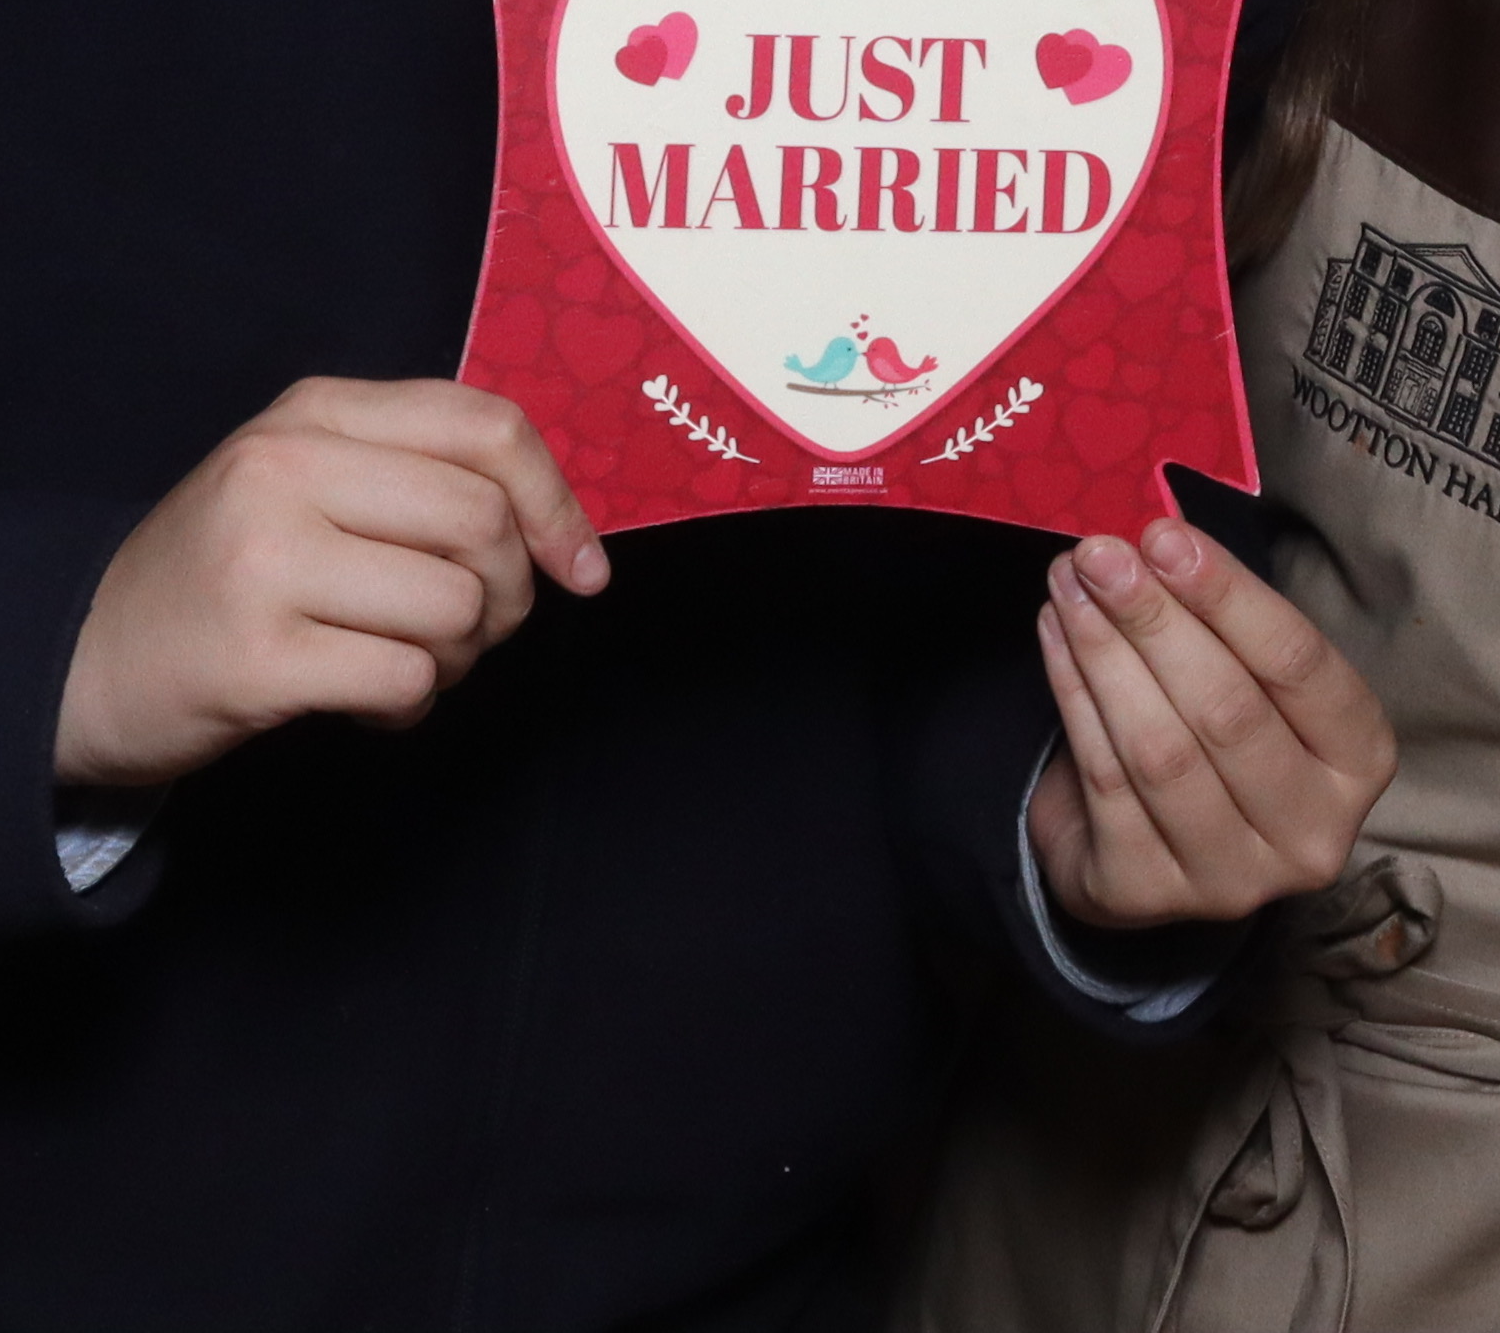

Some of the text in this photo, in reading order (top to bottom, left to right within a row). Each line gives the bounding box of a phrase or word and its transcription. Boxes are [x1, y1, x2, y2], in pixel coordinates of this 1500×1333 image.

[725, 33, 987, 124] JUST
[602, 141, 1114, 235] MARRIED
[1291, 364, 1439, 485] WOOTTON
[842, 466, 884, 477] MADE IN
[842, 475, 884, 486] BRITAIN
